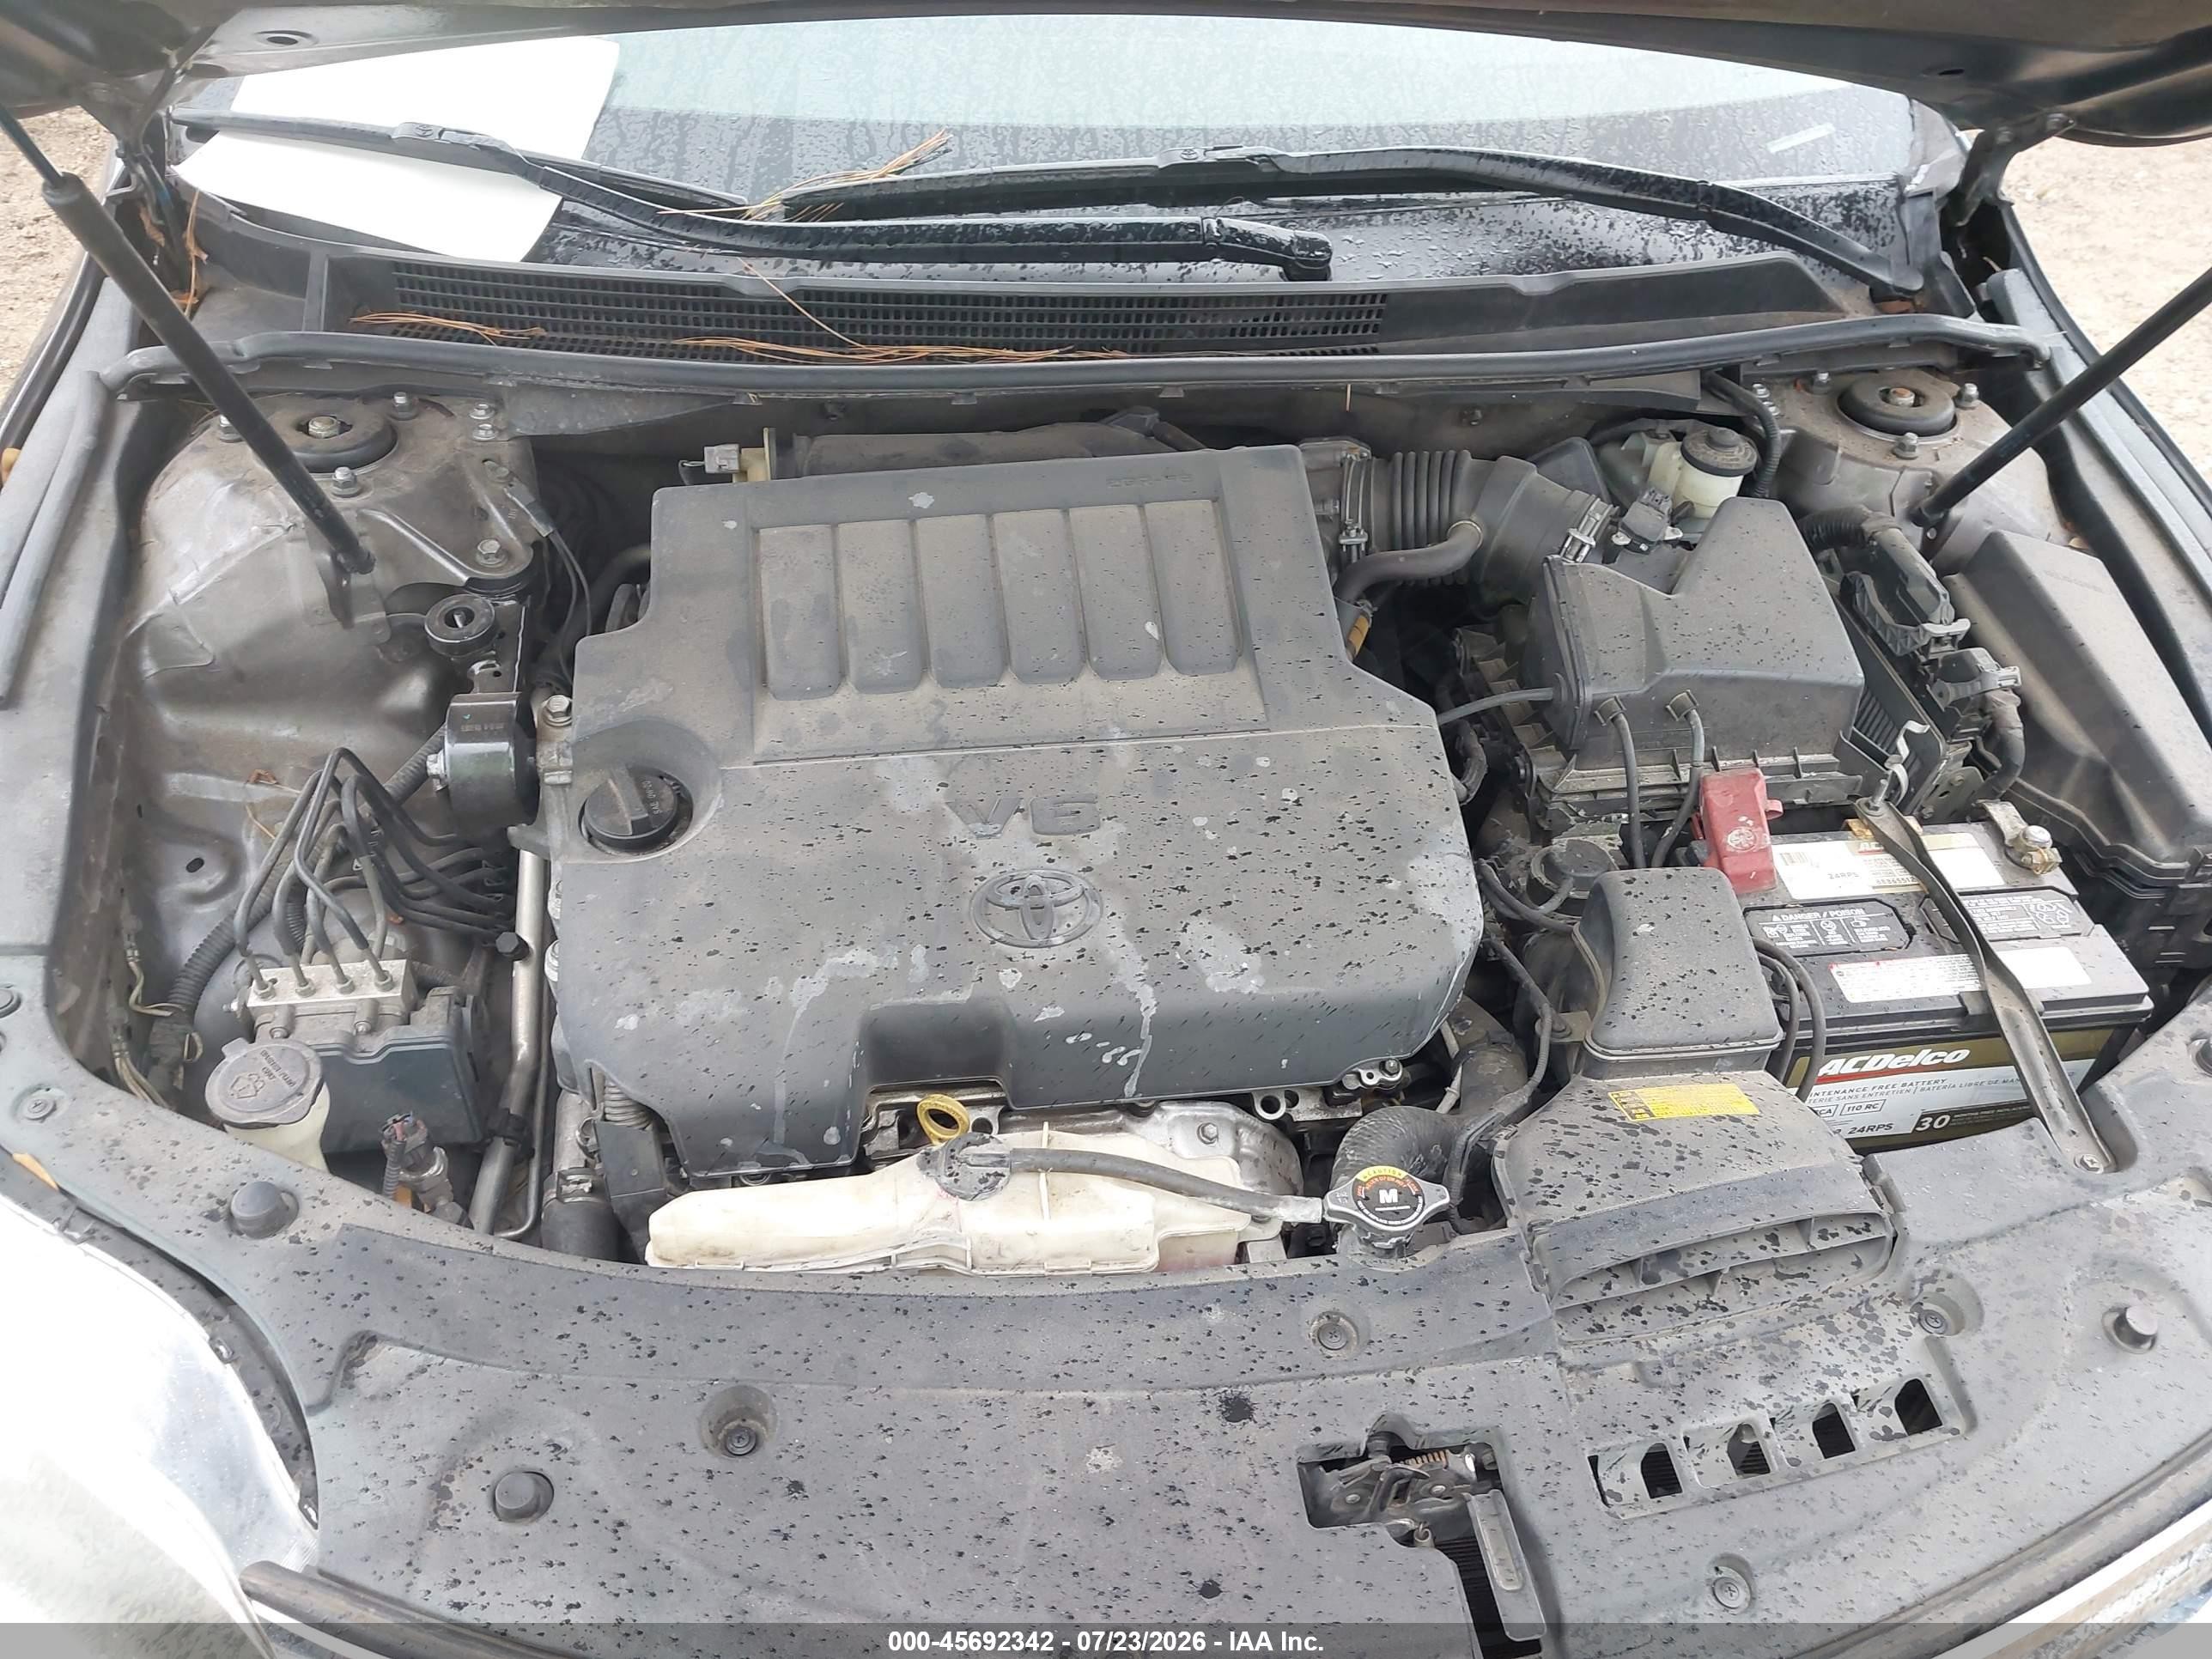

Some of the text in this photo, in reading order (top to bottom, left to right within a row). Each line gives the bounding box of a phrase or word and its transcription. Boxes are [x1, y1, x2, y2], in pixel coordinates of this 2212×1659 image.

[945, 793, 1101, 839] V6
[1781, 911, 1821, 921] DANGER
[1830, 908, 1866, 917] POISON
[1818, 1048, 1971, 1076] ACDelco
[1809, 1078, 1948, 1097] INTENANCE FREE BATTERY
[1862, 1087, 1911, 1099] ENTRETIEN
[1847, 1122, 1894, 1135] 24RPS
[1914, 1115, 1951, 1132] 30
[1378, 1188, 1398, 1204] M
